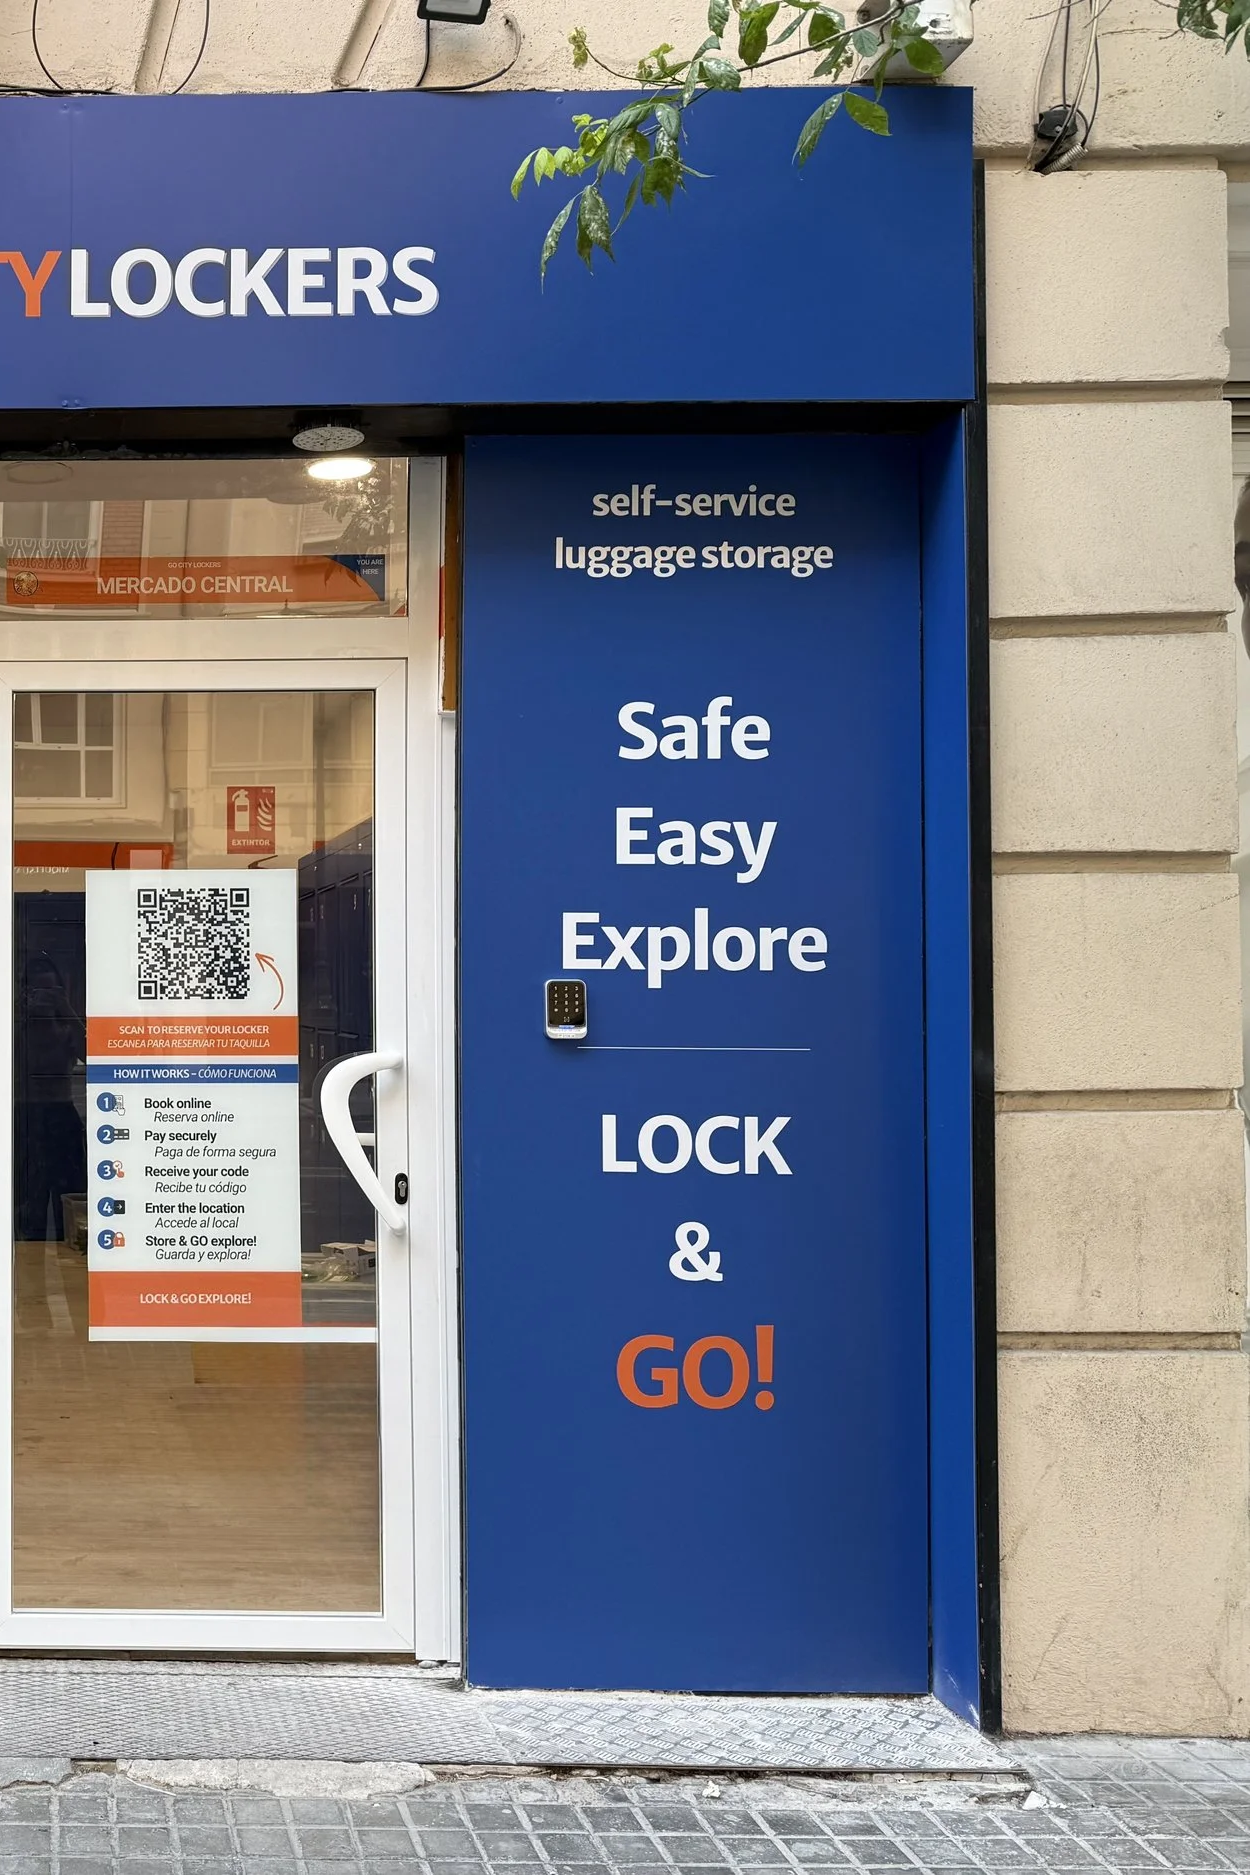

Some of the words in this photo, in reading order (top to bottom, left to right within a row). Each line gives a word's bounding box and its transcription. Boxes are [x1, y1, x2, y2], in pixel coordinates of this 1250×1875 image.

[68, 245, 440, 318] LOCKERS
[592, 484, 796, 517] self-service
[555, 537, 696, 578] luggage
[701, 541, 834, 578] storage
[97, 576, 197, 595] MERCADO
[200, 575, 293, 594] CENTRAL
[617, 696, 772, 760] Safe
[615, 807, 778, 883] Easy
[562, 907, 828, 989] Explore
[119, 1026, 144, 1035] SCAN
[148, 1026, 161, 1035] TO
[162, 1026, 203, 1035] RESERVE
[205, 1026, 231, 1035] YOUR
[232, 1026, 269, 1035] LOCKER
[107, 1039, 146, 1048] ESCANEA
[147, 1039, 171, 1048] PARA
[171, 1039, 215, 1048] RESERVAR
[217, 1039, 229, 1048] TU
[230, 1039, 270, 1048] TAQUILLA
[113, 1069, 140, 1079] HOW
[141, 1069, 150, 1079] IT
[151, 1069, 189, 1079] WORKS
[198, 1066, 227, 1079] CÓMO
[228, 1069, 277, 1079] FUNCIONA
[103, 1097, 109, 1108] 1
[144, 1098, 174, 1109] Book
[176, 1098, 212, 1109] online
[154, 1111, 198, 1122] Reserva
[200, 1111, 234, 1122] online
[102, 1129, 111, 1141] 2
[144, 1130, 166, 1143] Pay
[168, 1130, 217, 1143] securely
[602, 1114, 793, 1175] LOCK
[154, 1146, 183, 1160] Paga
[186, 1146, 200, 1157] de
[202, 1146, 236, 1157] forma
[238, 1149, 277, 1160] segura
[103, 1165, 111, 1176] 3
[145, 1166, 190, 1177] Receive
[192, 1168, 218, 1179] your
[220, 1166, 249, 1177] code
[155, 1182, 192, 1193] Recibe
[195, 1183, 206, 1193] tu
[208, 1182, 247, 1195] código
[102, 1202, 113, 1213] 4
[145, 1203, 175, 1214] Enter
[178, 1203, 198, 1214] the
[199, 1203, 245, 1214] location
[155, 1217, 197, 1228] Accede
[200, 1217, 210, 1228] al
[212, 1217, 239, 1228] local
[103, 1235, 111, 1246] 5
[145, 1236, 176, 1247] Store
[179, 1236, 187, 1247] &
[190, 1236, 208, 1247] GO
[211, 1236, 257, 1249] explore!
[155, 1249, 196, 1260] Guarda
[198, 1251, 205, 1263] y
[207, 1249, 252, 1263] explora!
[669, 1221, 723, 1282] &
[140, 1293, 169, 1304] LOCK
[170, 1293, 179, 1304] &
[180, 1293, 197, 1304] GO
[198, 1293, 252, 1304] EXPLORE!
[617, 1324, 775, 1410] GO!
